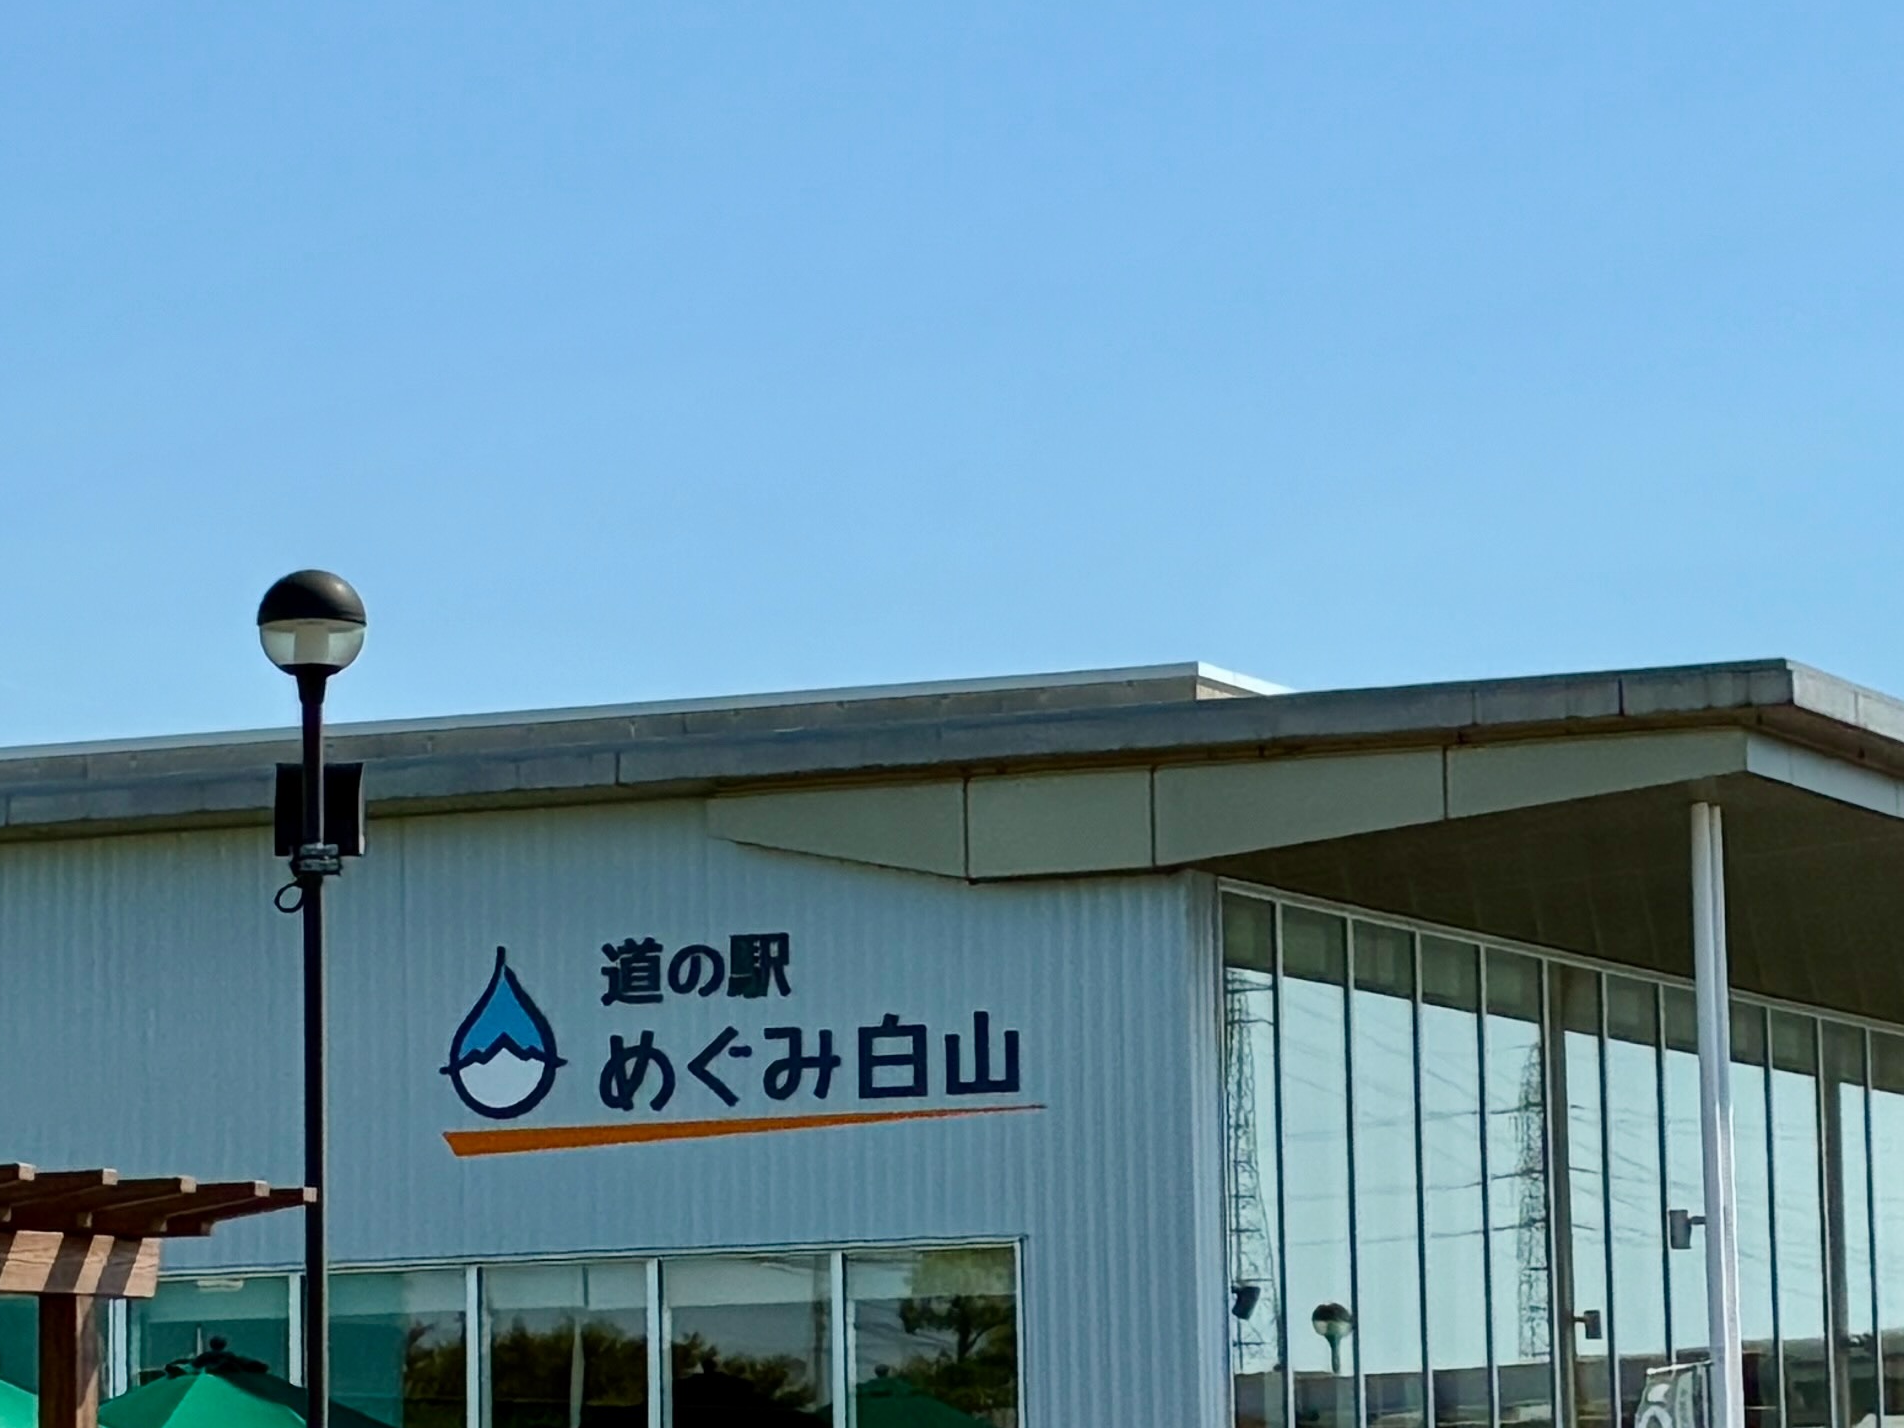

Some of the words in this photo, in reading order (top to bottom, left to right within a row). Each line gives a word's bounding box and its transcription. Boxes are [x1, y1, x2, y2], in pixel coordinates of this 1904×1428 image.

[601, 932, 791, 1006] 道の駅
[599, 1010, 1020, 1112] めぐみ白山
